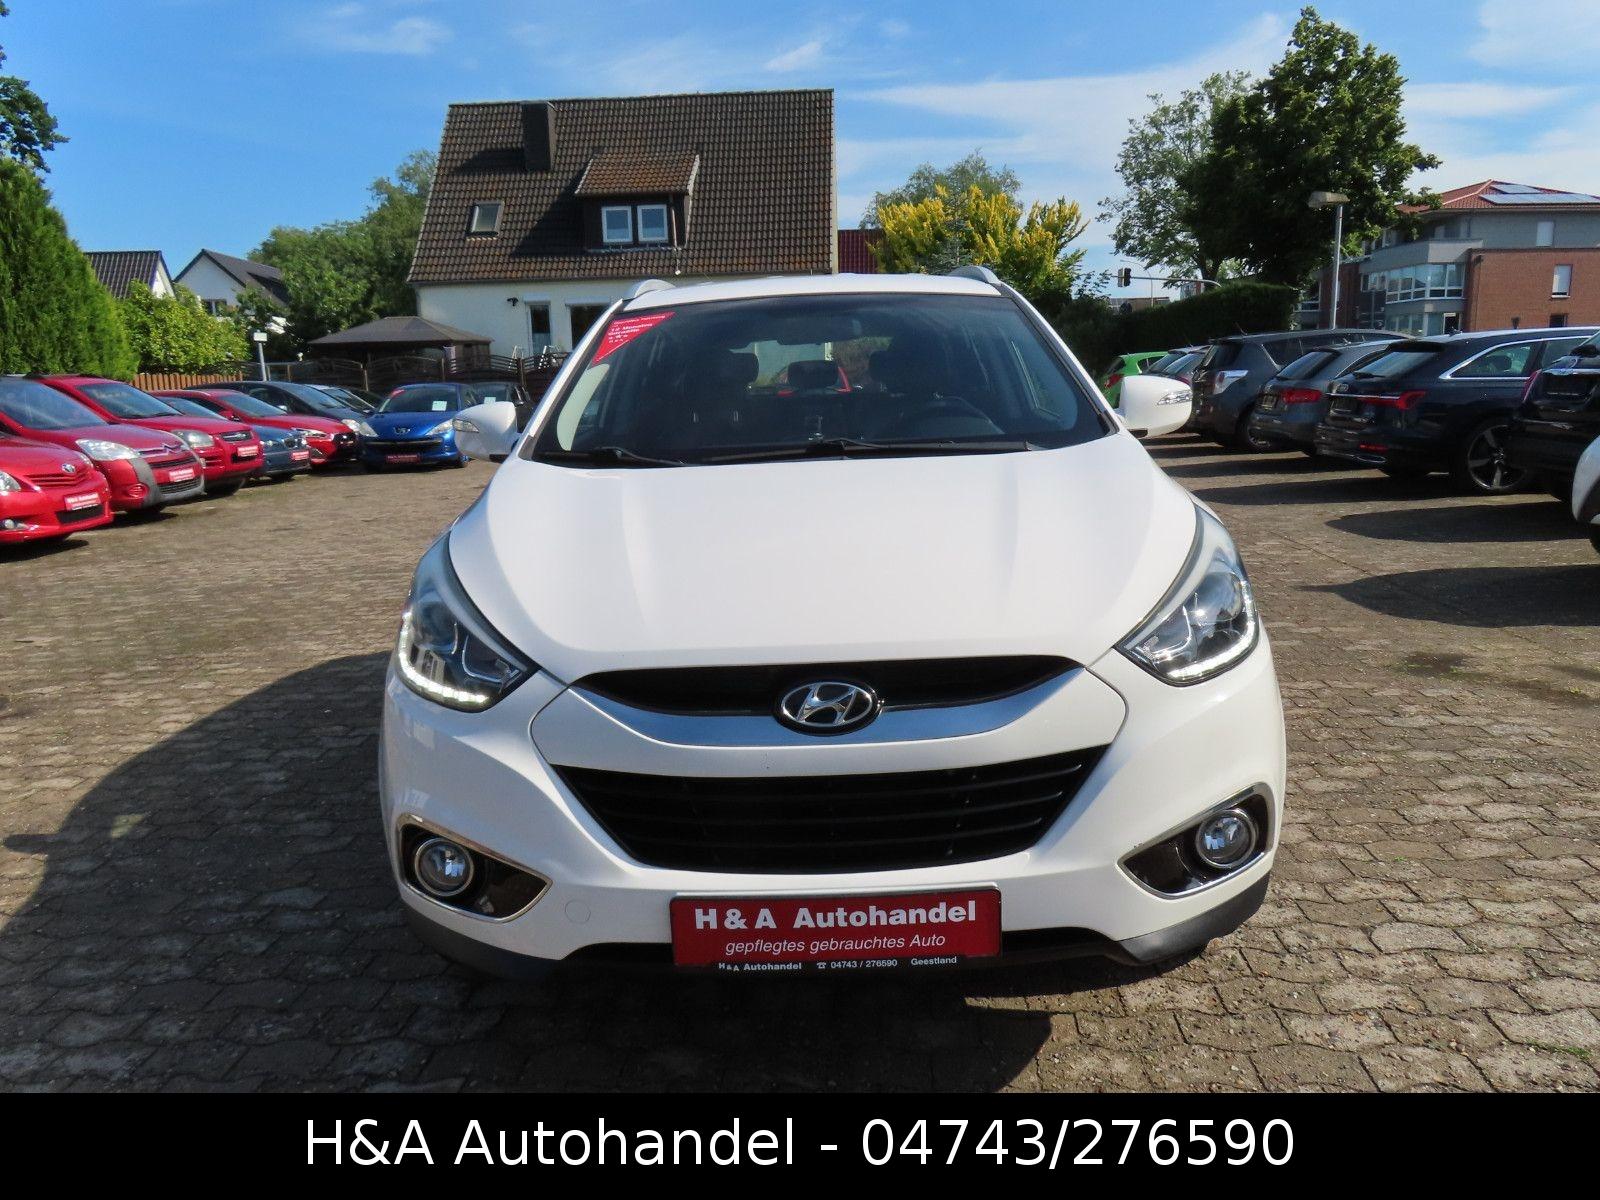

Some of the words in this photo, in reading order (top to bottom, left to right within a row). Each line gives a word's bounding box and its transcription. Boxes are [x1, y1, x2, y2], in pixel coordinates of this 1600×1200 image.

[792, 900, 977, 930] Autohandel
[724, 938, 806, 957] gepflegtes
[809, 934, 906, 956] gebrauchtes
[909, 932, 946, 949] Auto
[743, 962, 803, 972] Autohandel
[830, 960, 858, 970] 04743
[910, 955, 958, 967] Geestland
